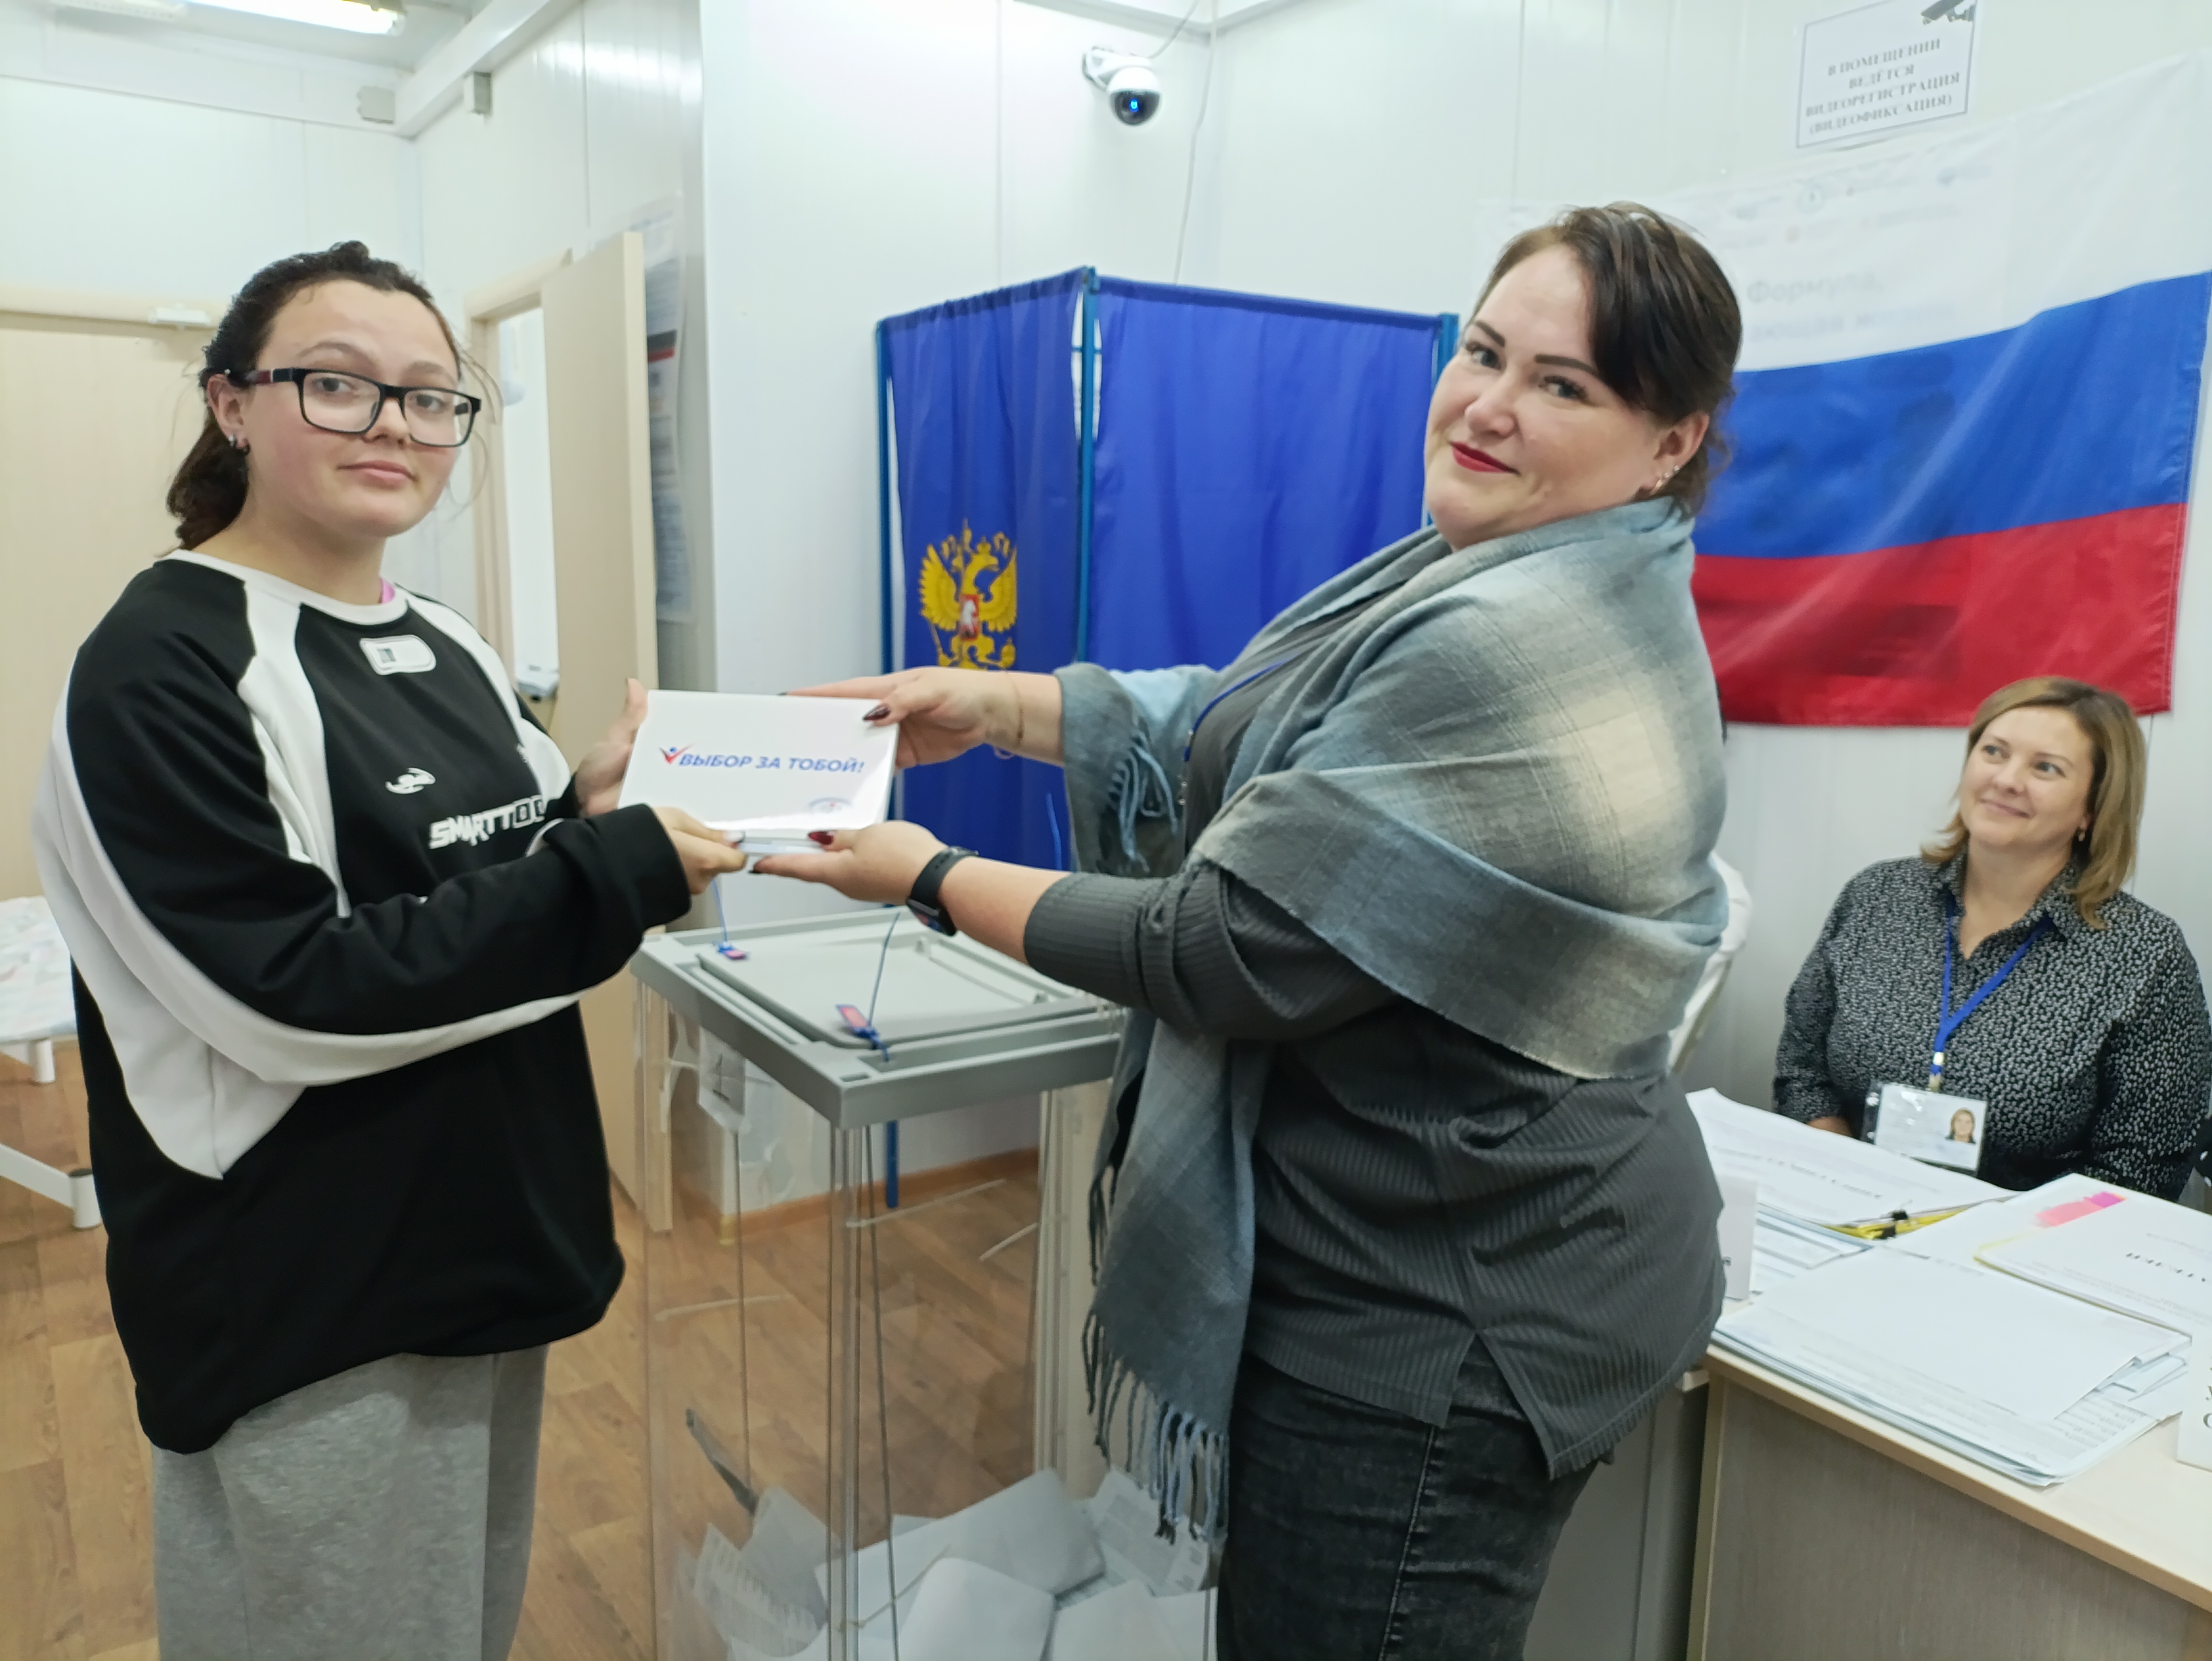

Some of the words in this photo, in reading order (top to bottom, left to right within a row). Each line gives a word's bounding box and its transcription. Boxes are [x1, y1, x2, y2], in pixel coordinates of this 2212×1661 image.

[1828, 65, 1836, 76] В
[1839, 38, 1940, 73] ПОМЕЩЕНИИ
[1805, 71, 1959, 117] ВИДЕОРЕГИСТРАЦИЯ
[1809, 94, 1952, 134] (ВИДЕОФИКСАЦИЯ)
[679, 753, 752, 768] ВЫБОР
[755, 755, 780, 769] ЗА
[789, 757, 865, 773] ТОБОЙ!
